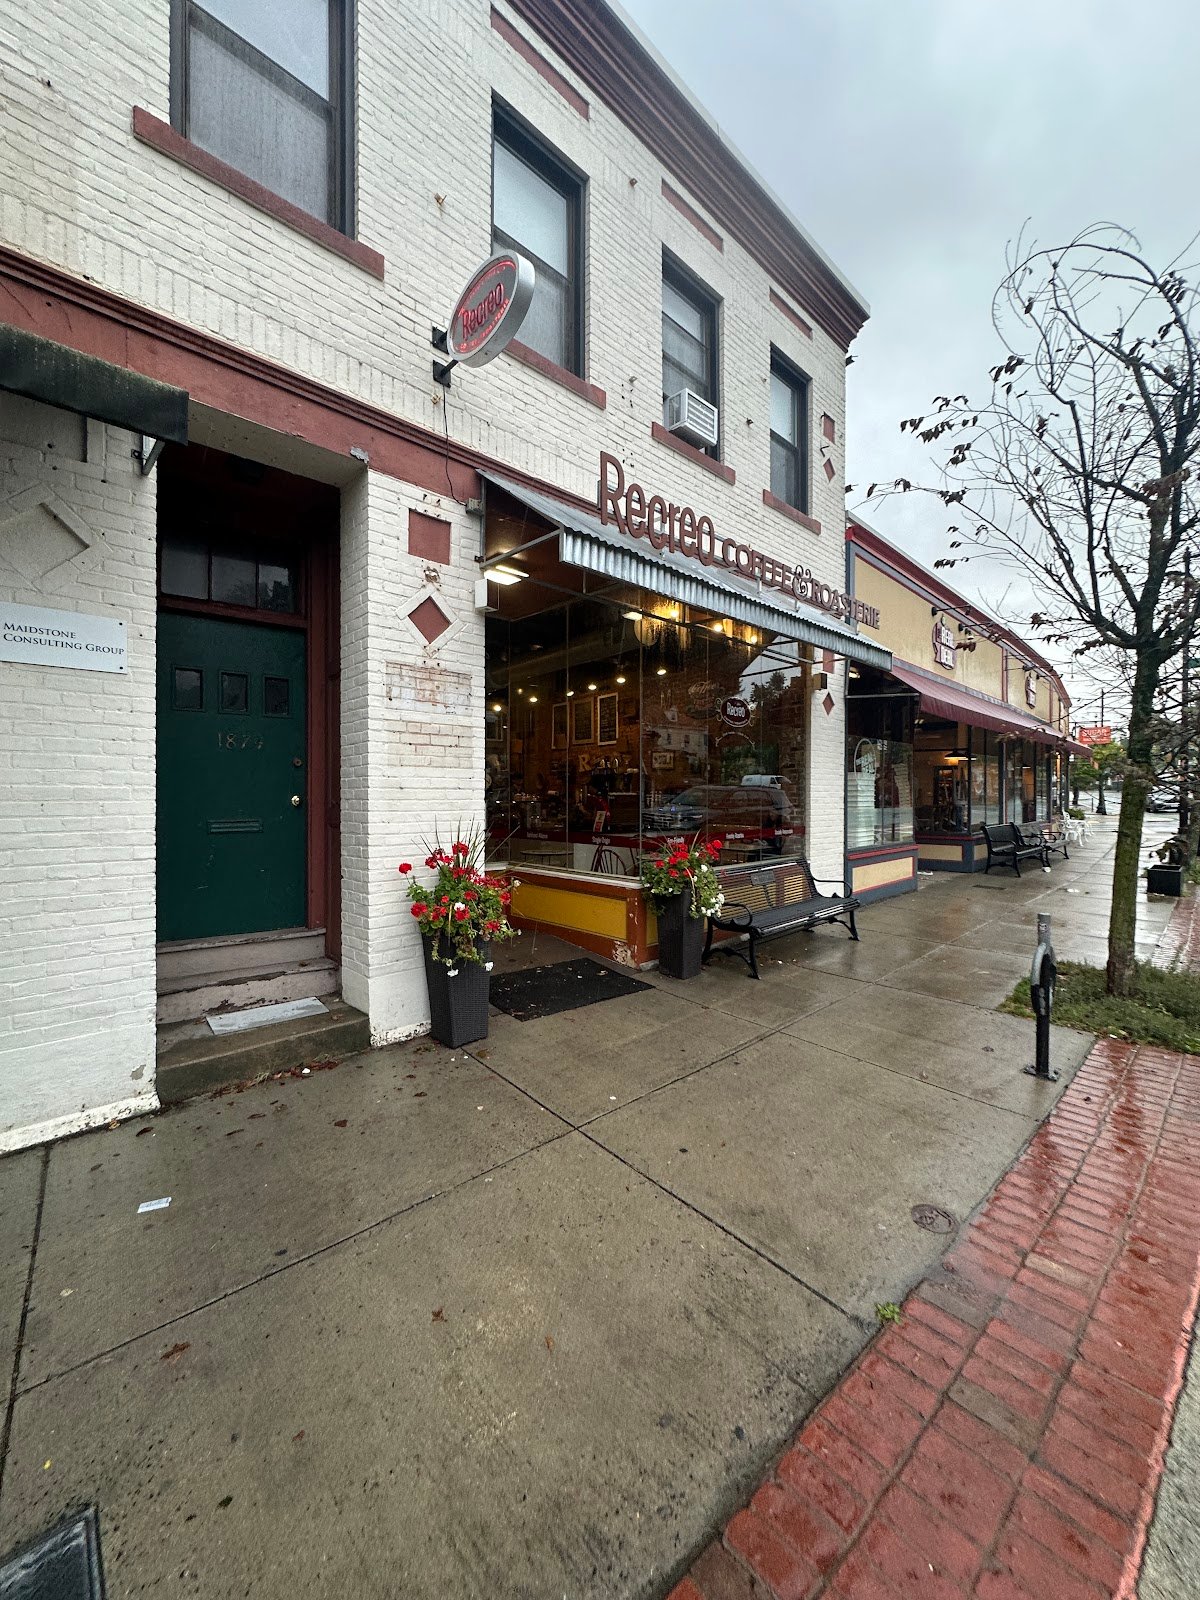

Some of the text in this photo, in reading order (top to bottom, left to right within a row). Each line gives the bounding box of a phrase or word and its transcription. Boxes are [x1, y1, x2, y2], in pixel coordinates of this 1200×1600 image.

[463, 283, 504, 341] Recreo
[600, 450, 880, 629] Recreo COFFEE & ROASTERIE
